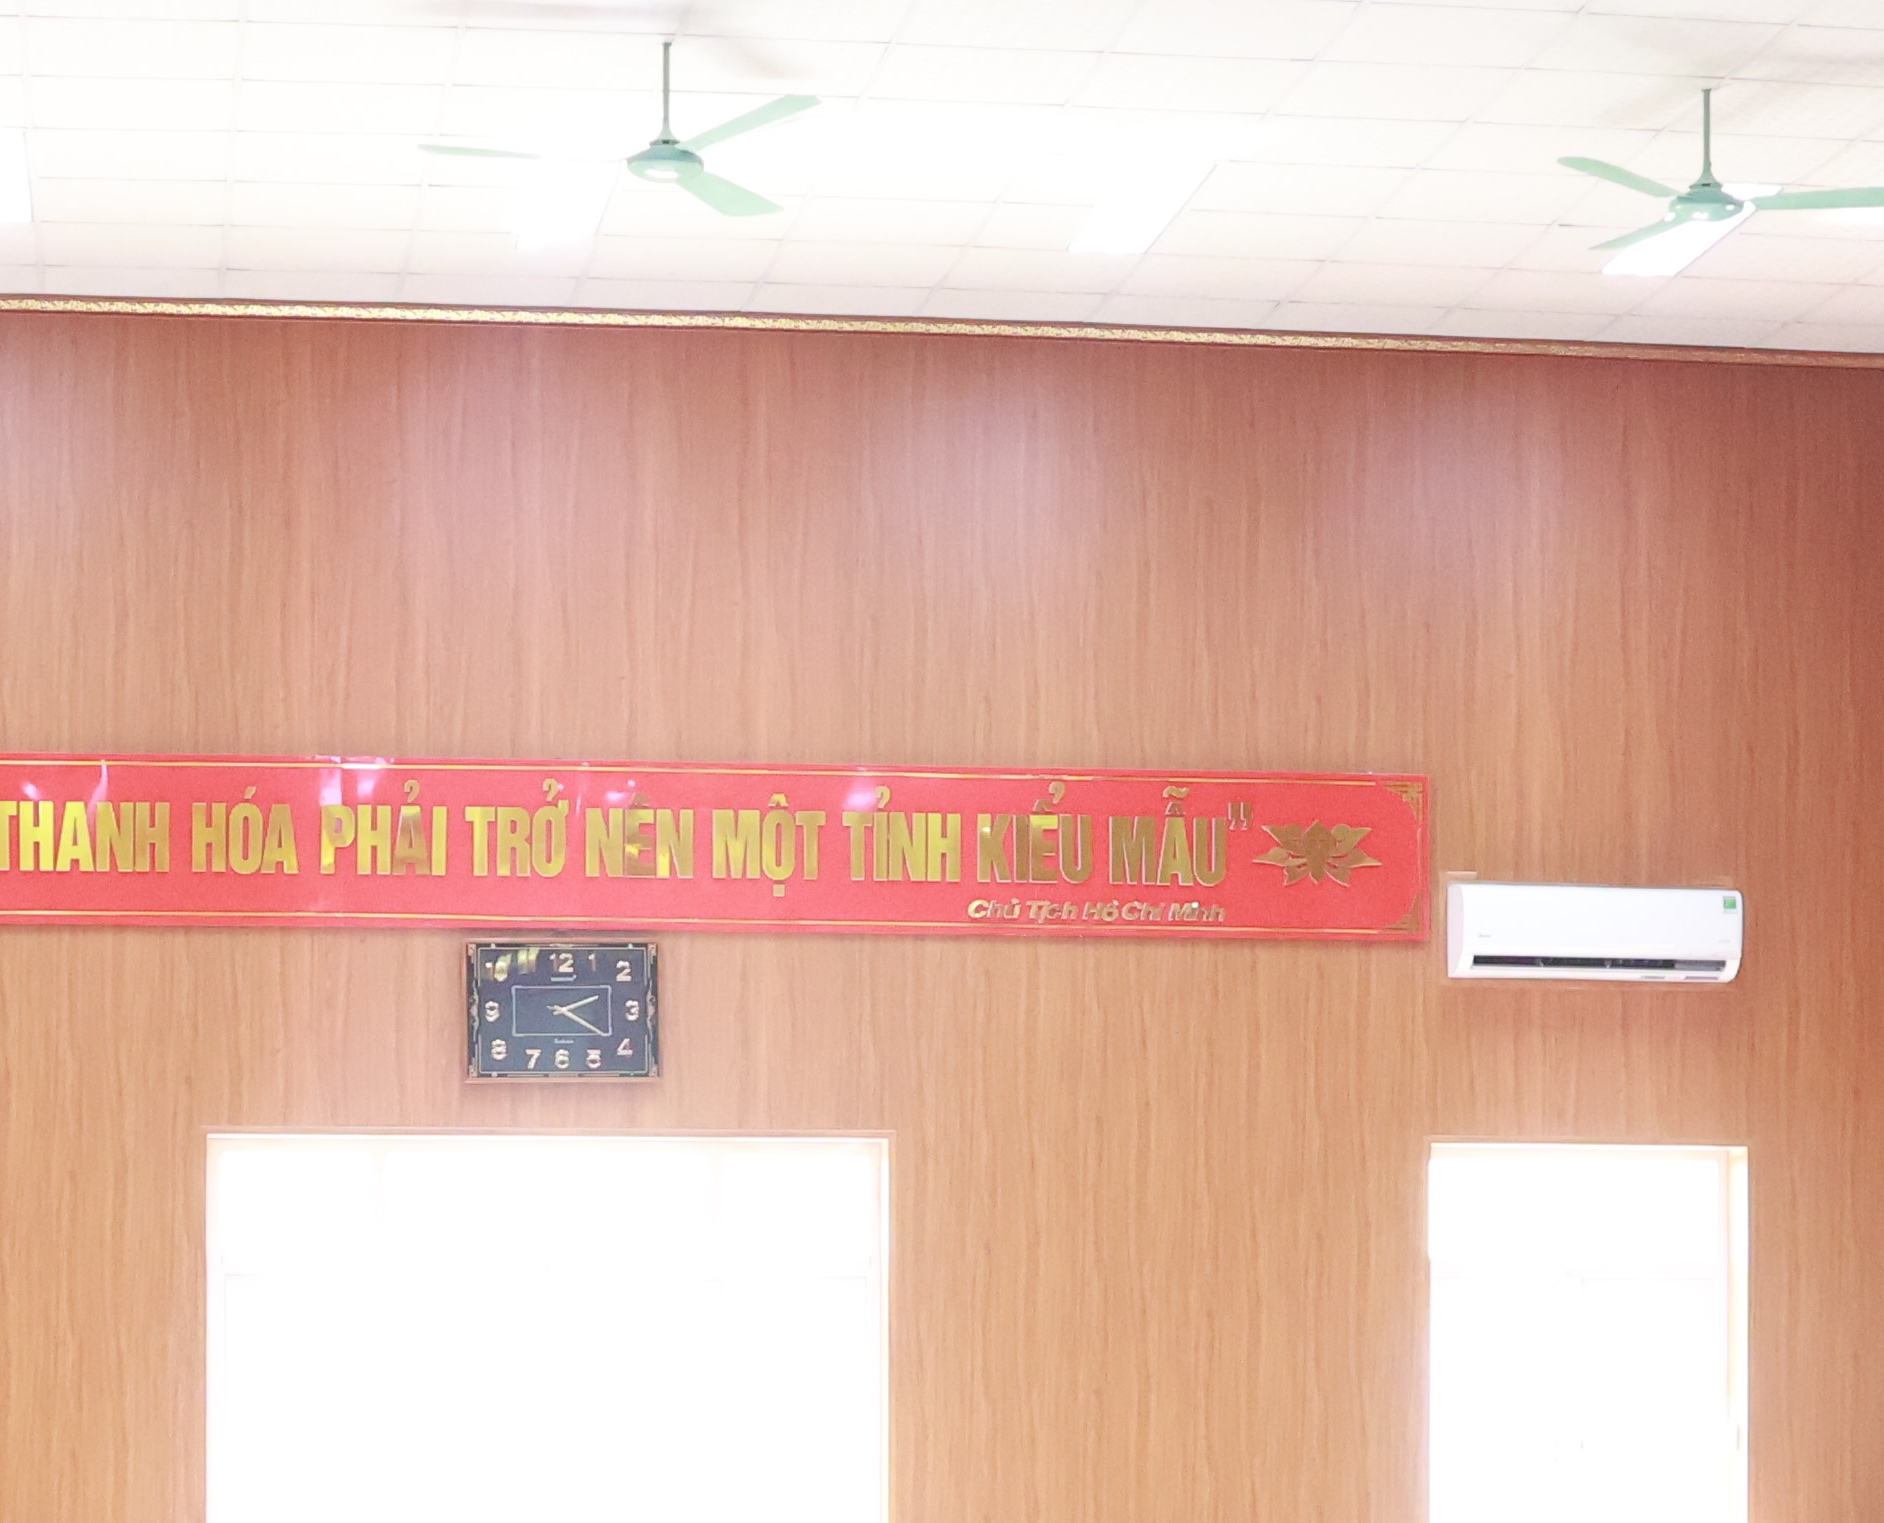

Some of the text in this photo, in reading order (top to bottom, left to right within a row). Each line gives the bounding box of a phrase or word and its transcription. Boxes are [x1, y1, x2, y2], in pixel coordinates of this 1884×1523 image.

[192, 786, 299, 875] HÓA
[320, 780, 448, 875] PHẢI
[464, 778, 569, 877] TRỞ
[585, 793, 694, 879] NÊN
[712, 794, 826, 897] MỘT
[842, 786, 961, 882] TỈNH
[977, 781, 1092, 884] KIỂU
[549, 953, 574, 972] 12
[616, 960, 632, 981] 2
[625, 1000, 639, 1021] 3
[617, 1038, 633, 1056] 4
[526, 1049, 541, 1069] 7
[555, 1049, 570, 1069] 6
